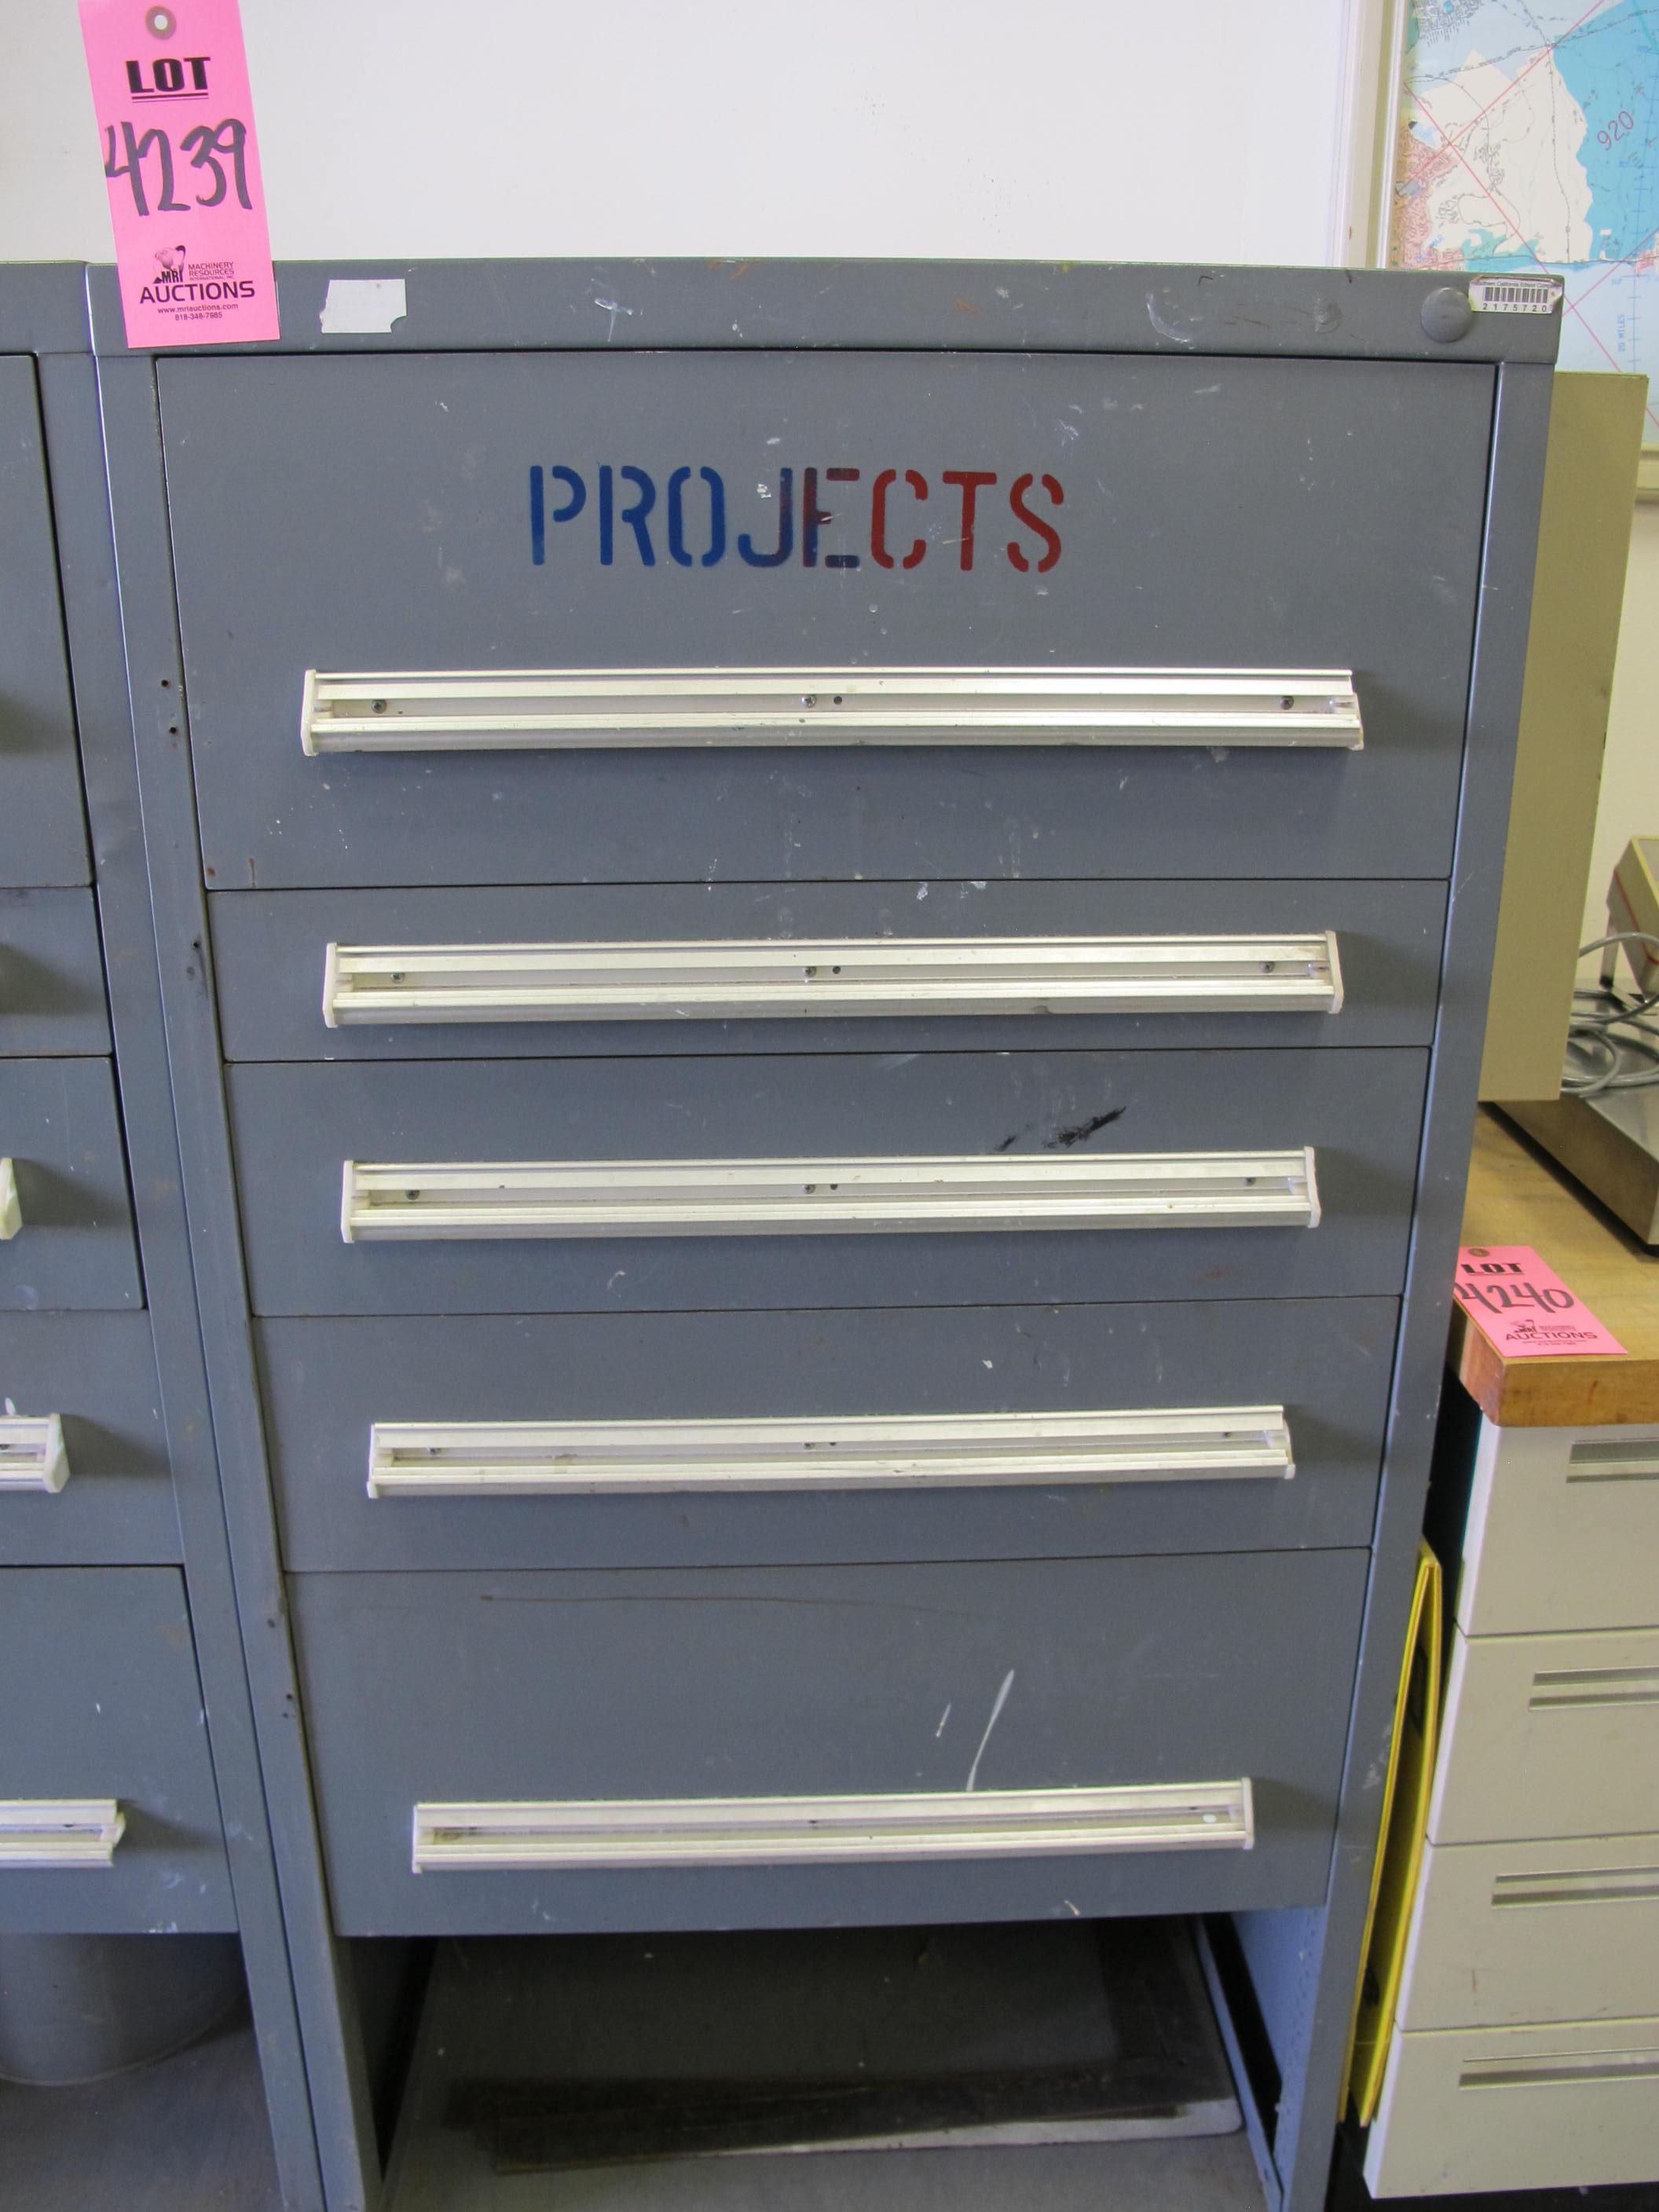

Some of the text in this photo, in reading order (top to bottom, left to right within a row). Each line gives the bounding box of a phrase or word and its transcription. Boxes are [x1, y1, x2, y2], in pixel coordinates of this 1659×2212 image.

[126, 57, 211, 93] LOT
[1597, 111, 1634, 151] 920
[104, 119, 253, 216] 4239
[161, 269, 184, 284] MRI
[188, 262, 234, 270] MACHINERY
[189, 269, 234, 277] RESOURCES
[140, 280, 255, 304] AUCTIONS
[157, 303, 239, 314] www.mriauctions.com
[530, 465, 1064, 573] PROJECTS
[1460, 1262, 1522, 1273] LOT
[1454, 1282, 1574, 1314] 4240
